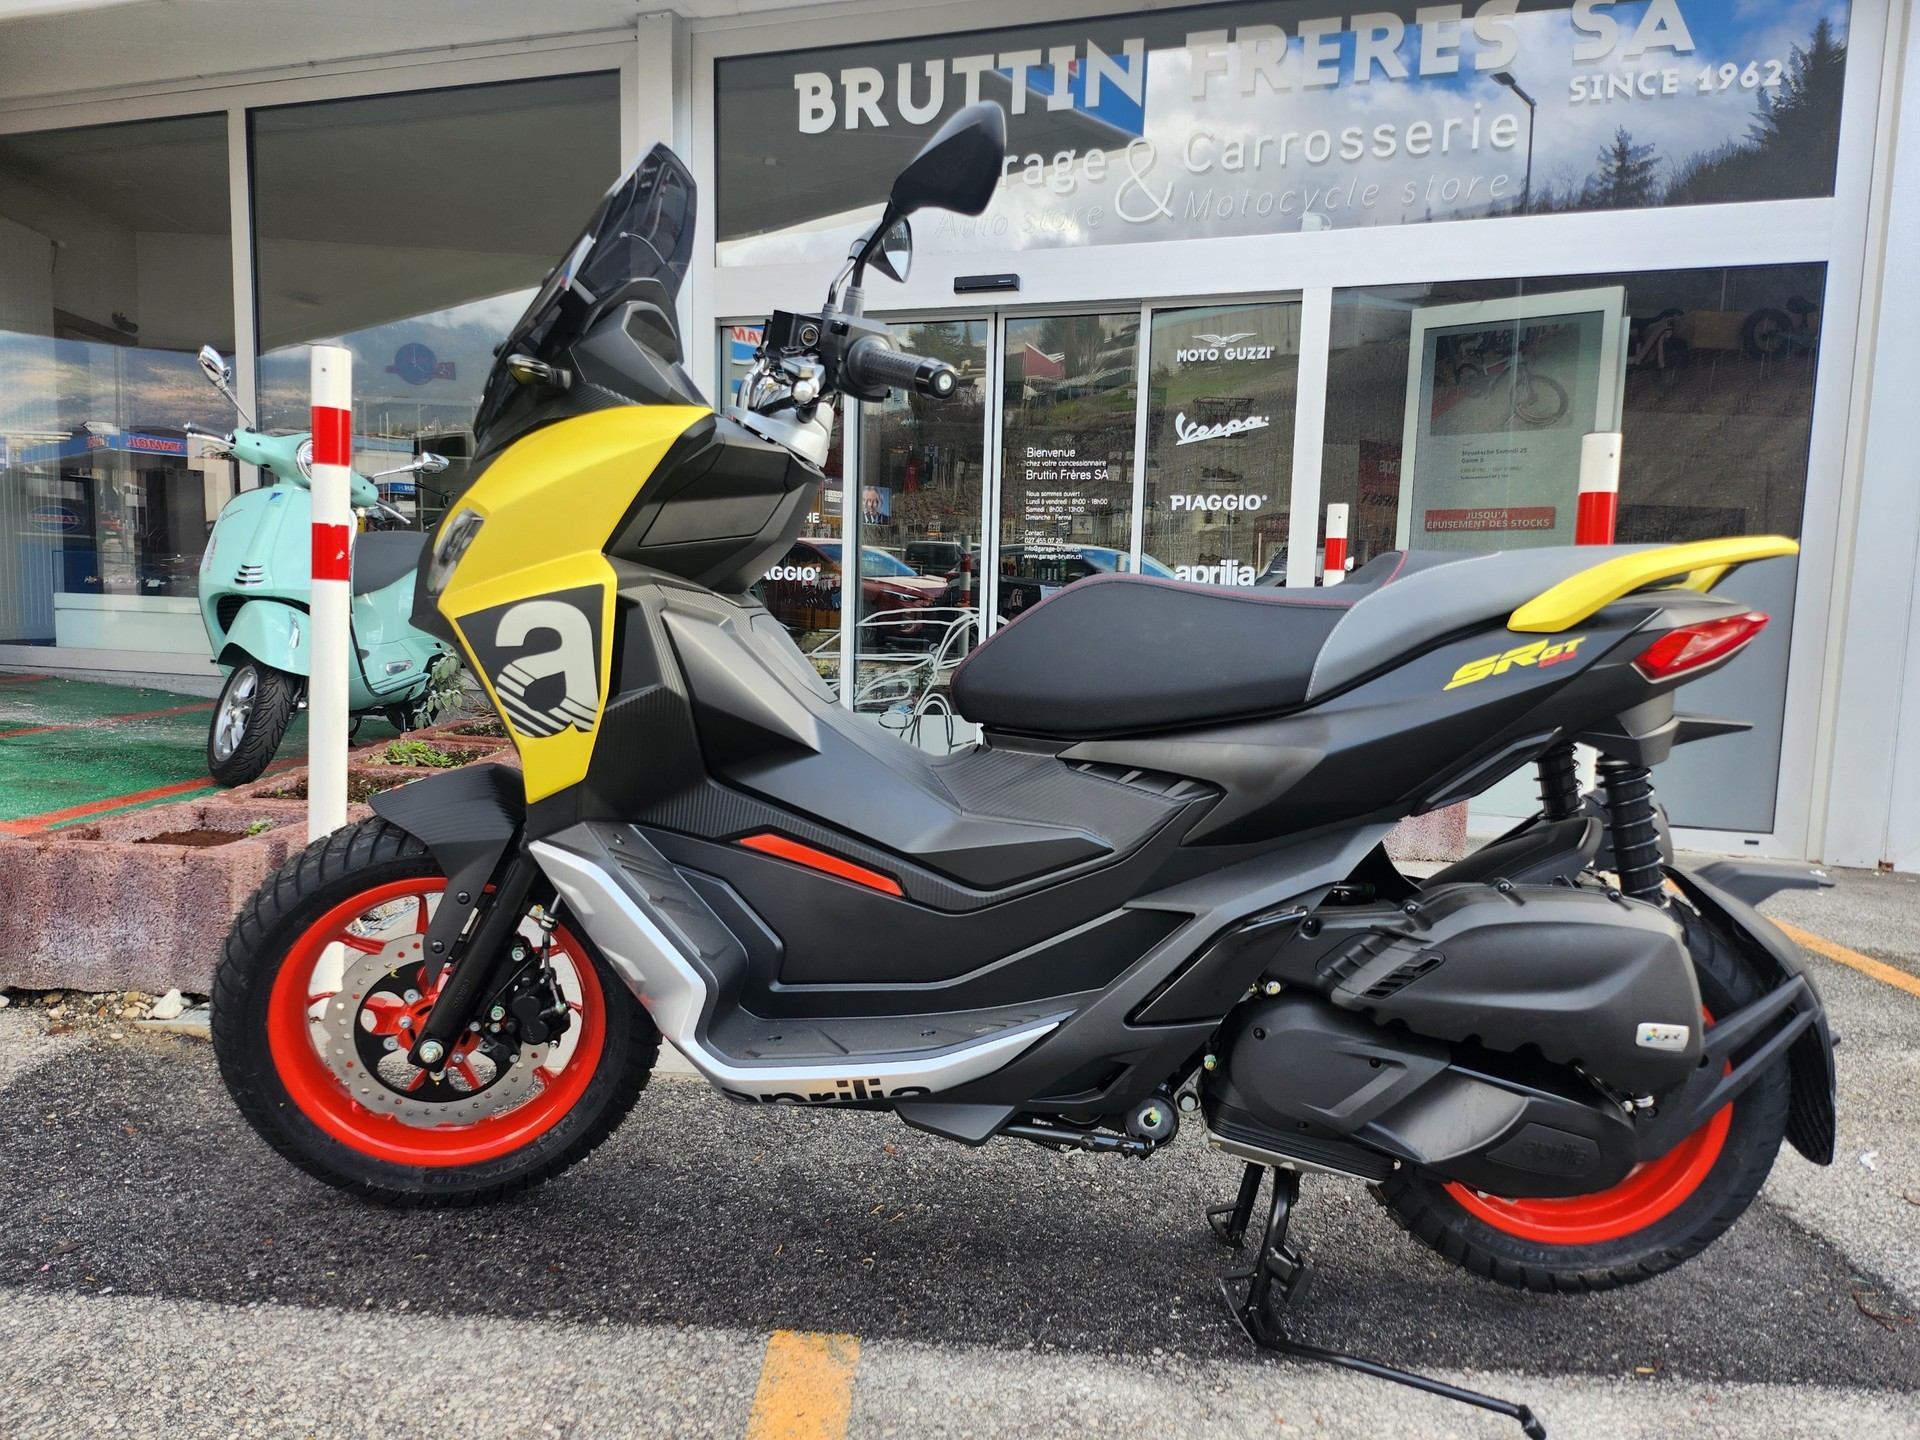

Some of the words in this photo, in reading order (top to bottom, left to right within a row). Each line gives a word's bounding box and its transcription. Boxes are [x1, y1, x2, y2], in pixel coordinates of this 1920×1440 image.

[794, 38, 1144, 134] BRUTTIN
[1185, 0, 1519, 99] FRERES
[1571, 0, 1696, 61] SA
[1569, 68, 1679, 102] SINCE
[1697, 59, 1783, 92] 1962
[1001, 148, 1106, 193] rage
[1183, 103, 1518, 172] Carrosserie
[1184, 177, 1380, 221] Motocycle
[1402, 174, 1508, 203] store
[934, 211, 1009, 240] Auto
[1022, 205, 1104, 233] store
[1176, 348, 1219, 363] MOTO
[1224, 346, 1272, 361] GUZZI
[1175, 412, 1270, 445] Vespa
[1026, 447, 1076, 458] Bienvenue
[1026, 459, 1041, 467] chez
[1042, 459, 1058, 467] votre
[1058, 459, 1107, 467] concessionnaire
[1026, 469, 1058, 480] Bruttin
[1060, 469, 1092, 480] Frères
[1094, 469, 1109, 480] SA
[1170, 494, 1262, 511] PIAGGIO
[1054, 513, 1072, 521] Fermé
[1488, 519, 1508, 528] DES
[1511, 518, 1550, 528] STOCKS
[1174, 559, 1255, 586] aprilia
